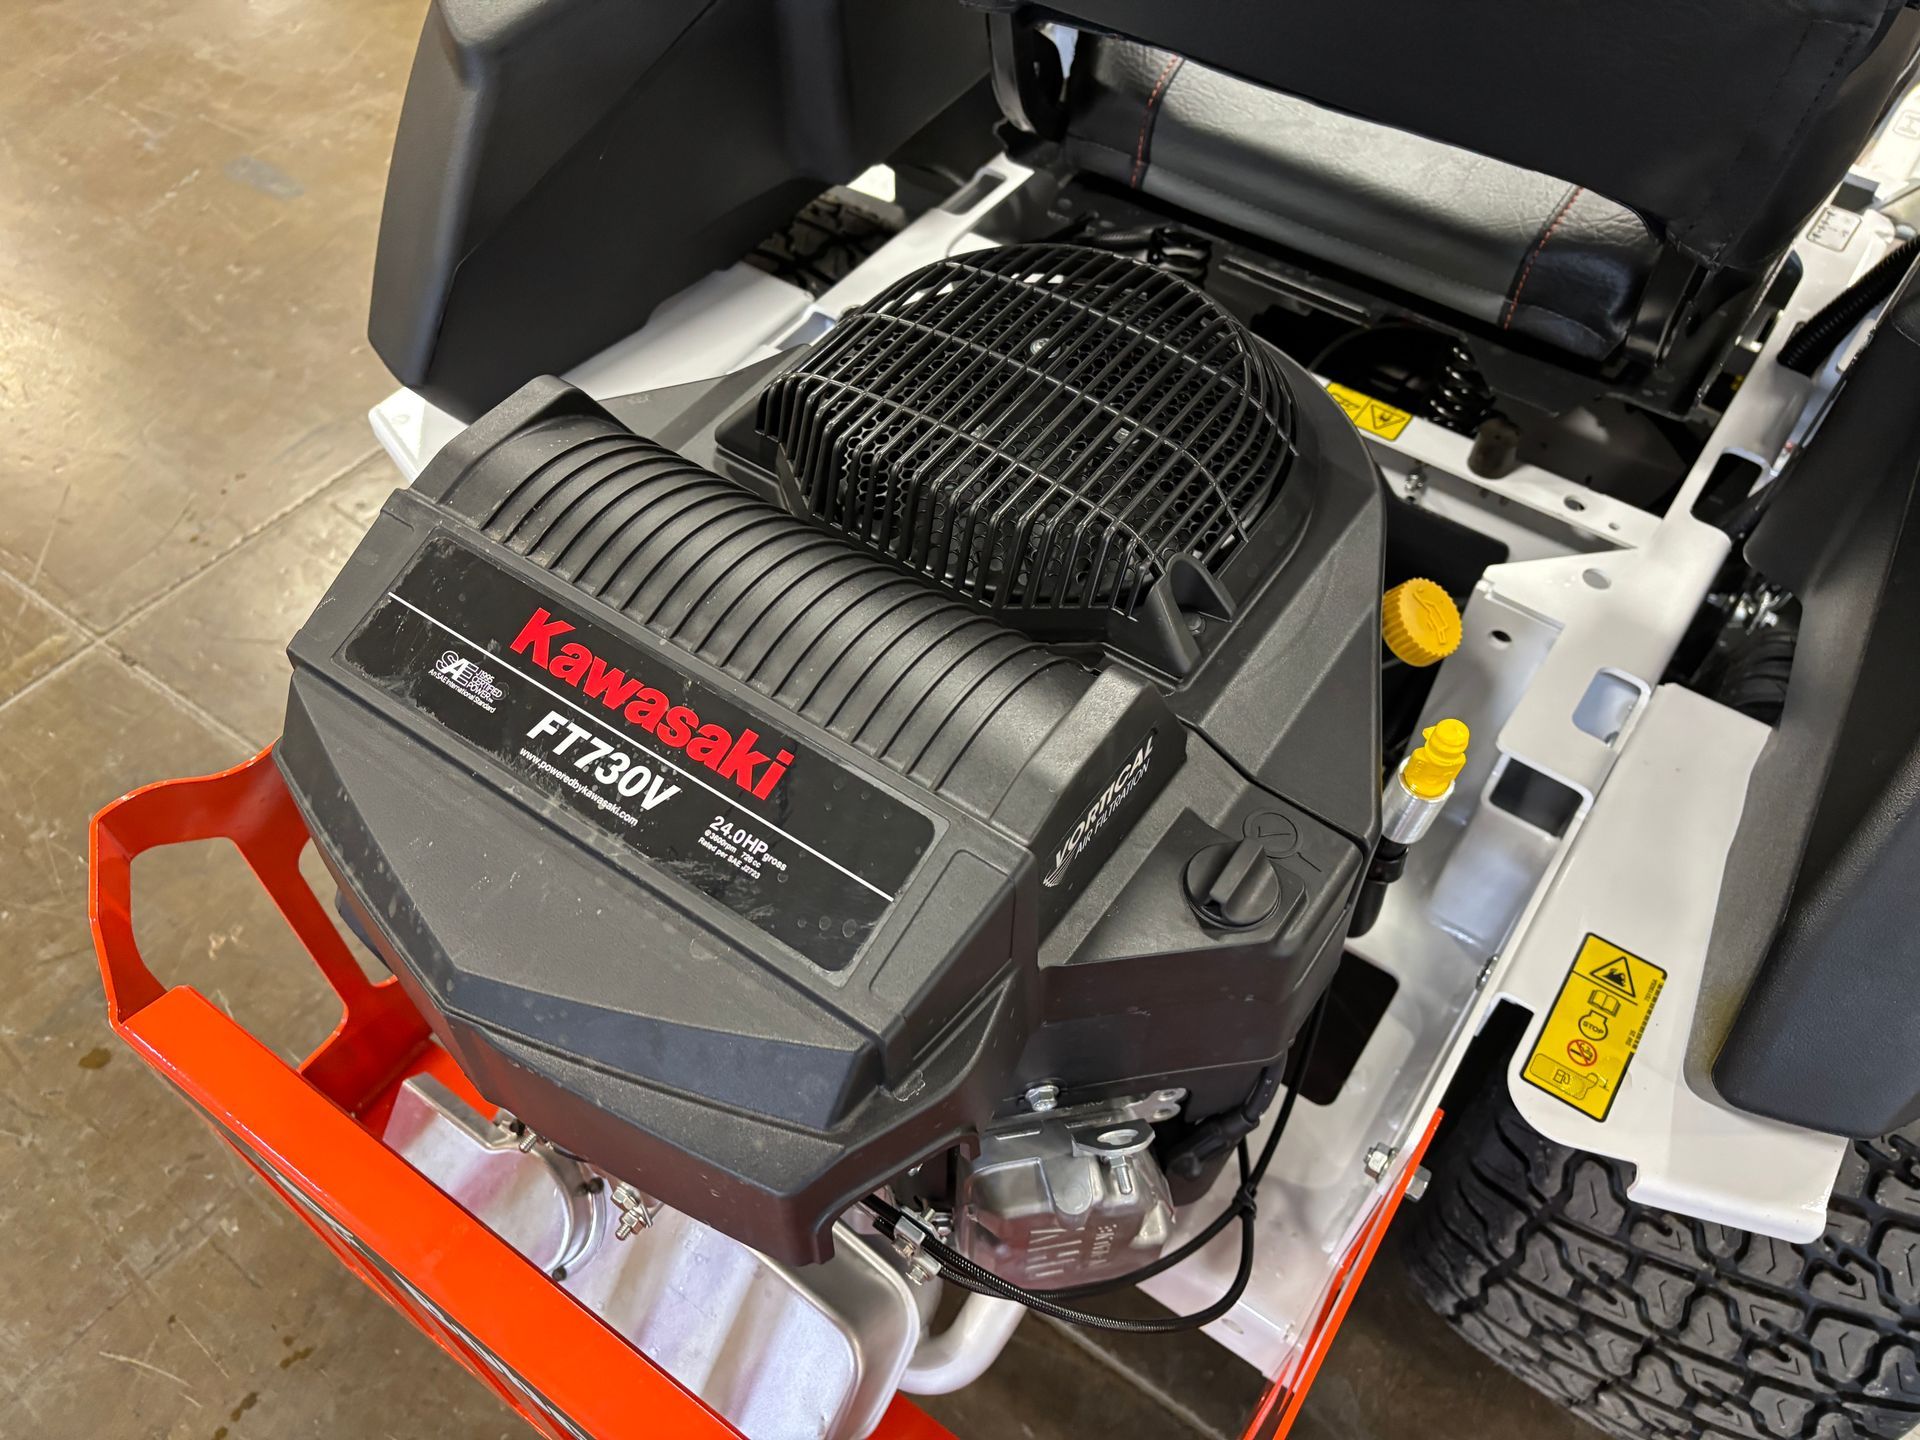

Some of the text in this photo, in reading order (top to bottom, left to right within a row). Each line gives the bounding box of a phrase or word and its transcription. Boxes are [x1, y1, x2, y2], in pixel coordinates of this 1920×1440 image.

[428, 668, 496, 714] An SAE International Standard
[436, 650, 479, 688] SAE
[471, 675, 502, 698] CERTIFIED
[476, 670, 496, 684] J1995
[510, 607, 795, 800] Kawasaki
[526, 710, 682, 811] FT730V
[519, 747, 638, 827] www.poweredbykawasaki.com
[1055, 735, 1154, 869] VORTICAL
[1074, 758, 1151, 860] AIR FILTRATION
[698, 836, 761, 880] Rated per SAE J2723
[761, 852, 787, 871] gross
[1582, 1020, 1604, 1035] STOP
